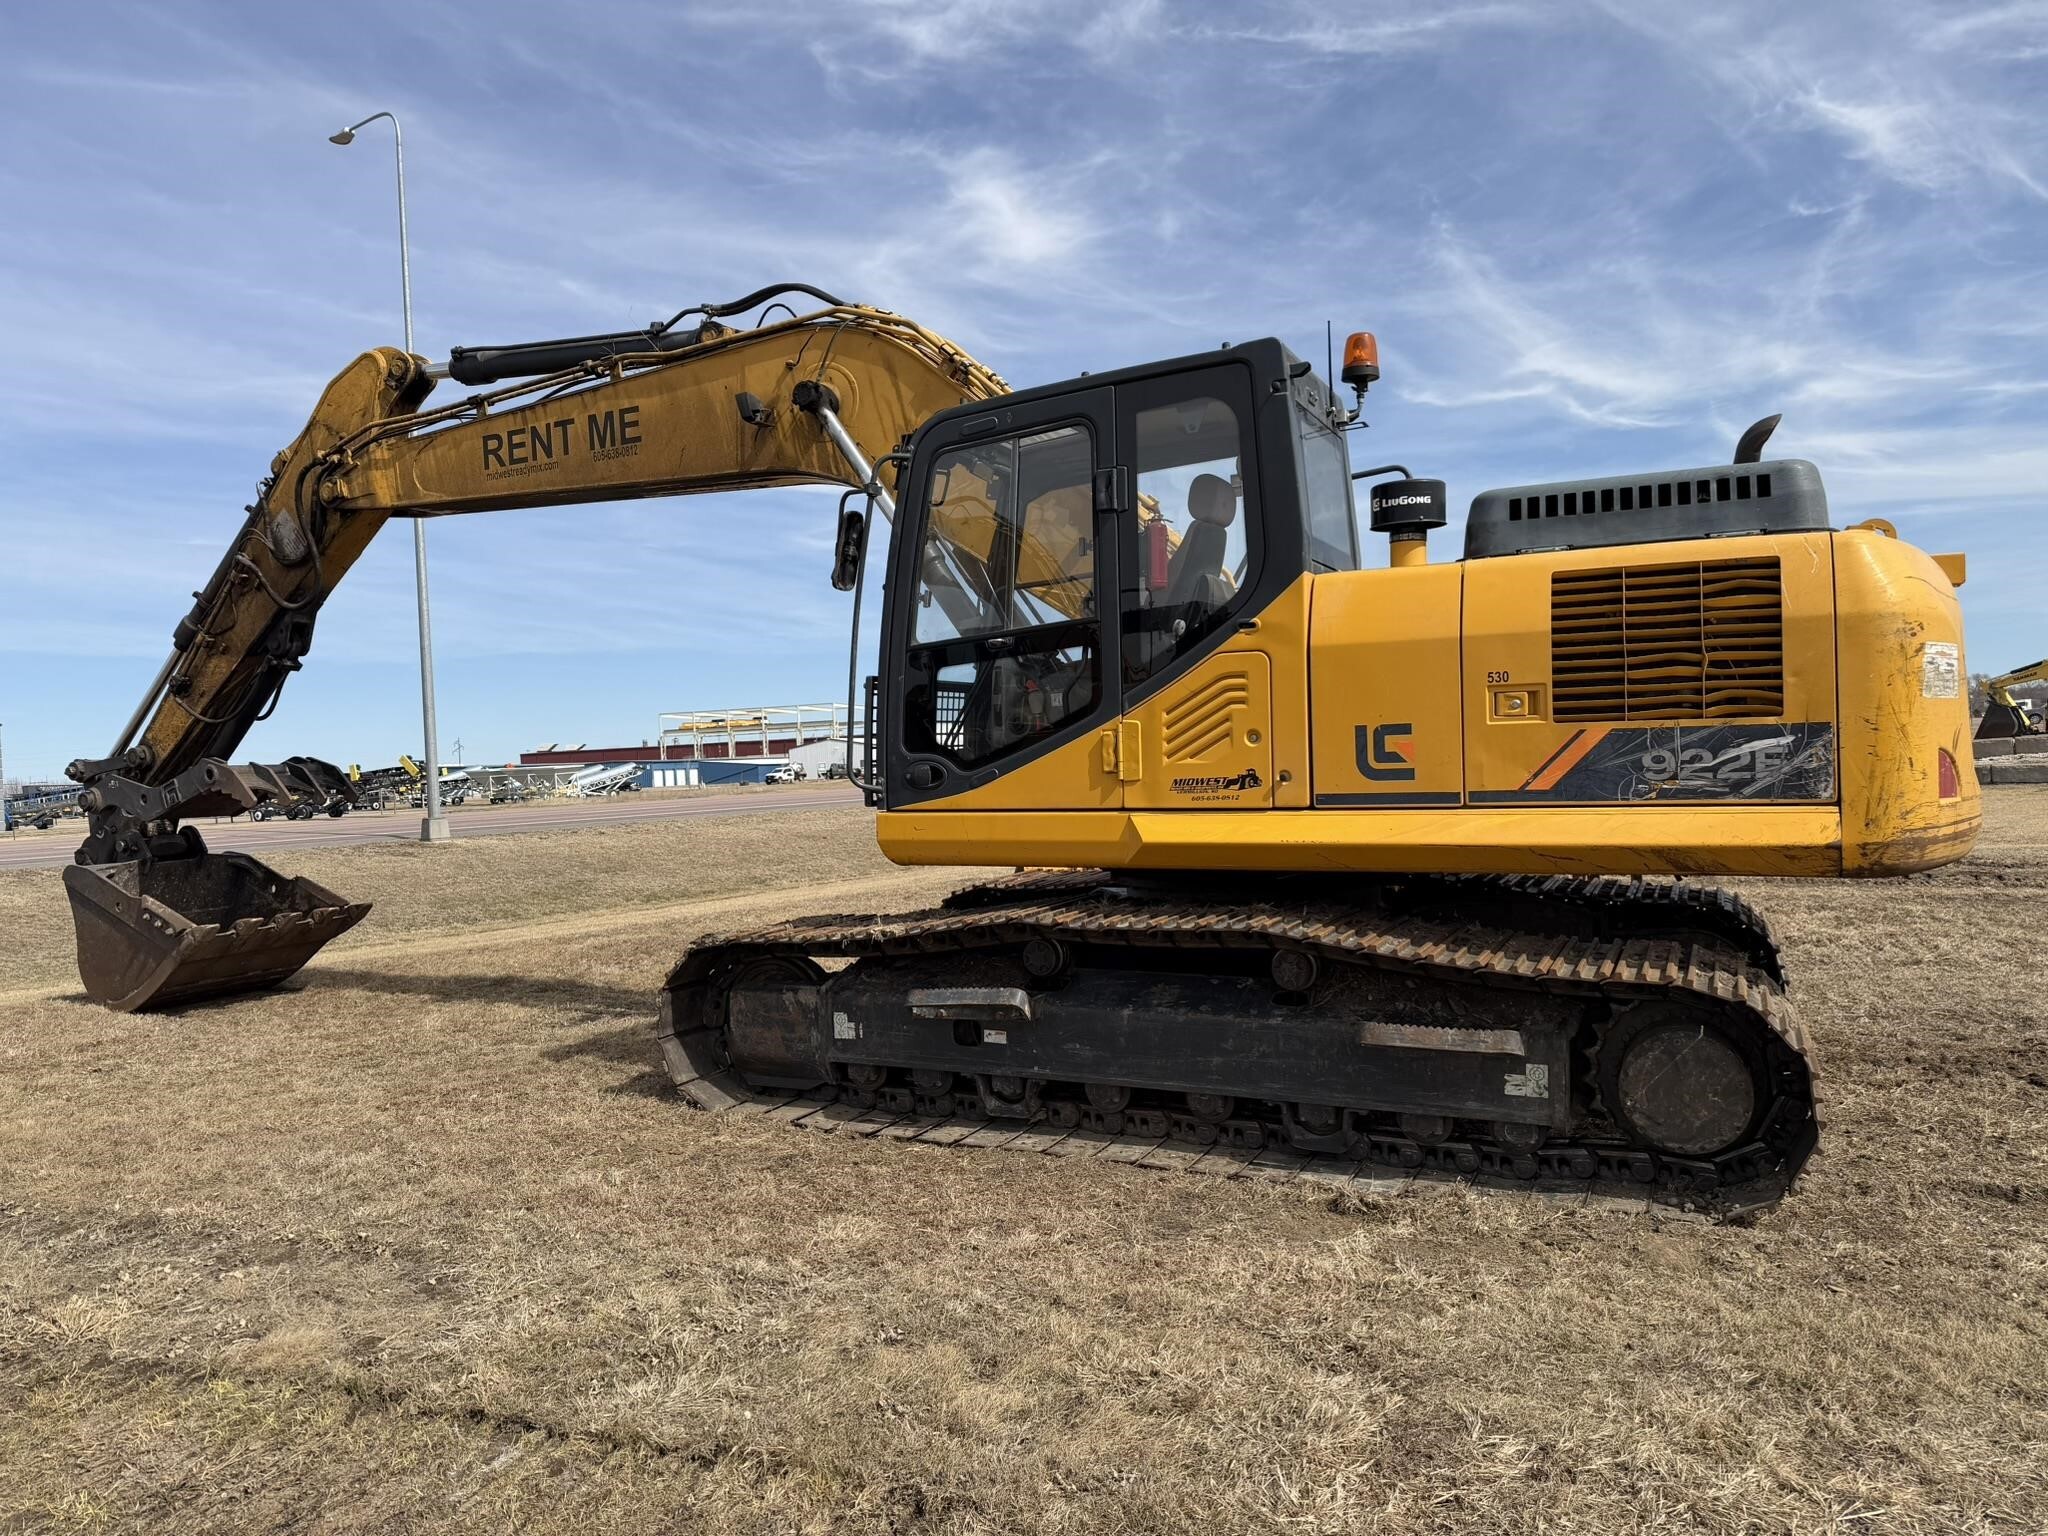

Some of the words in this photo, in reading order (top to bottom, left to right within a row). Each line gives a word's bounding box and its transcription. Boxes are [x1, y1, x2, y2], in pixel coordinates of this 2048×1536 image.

[482, 418, 575, 470] RENT
[587, 405, 642, 451] ME
[486, 460, 559, 481] midwestreadymix.com
[1487, 670, 1509, 683] 530
[1171, 776, 1229, 786] MIDWEST
